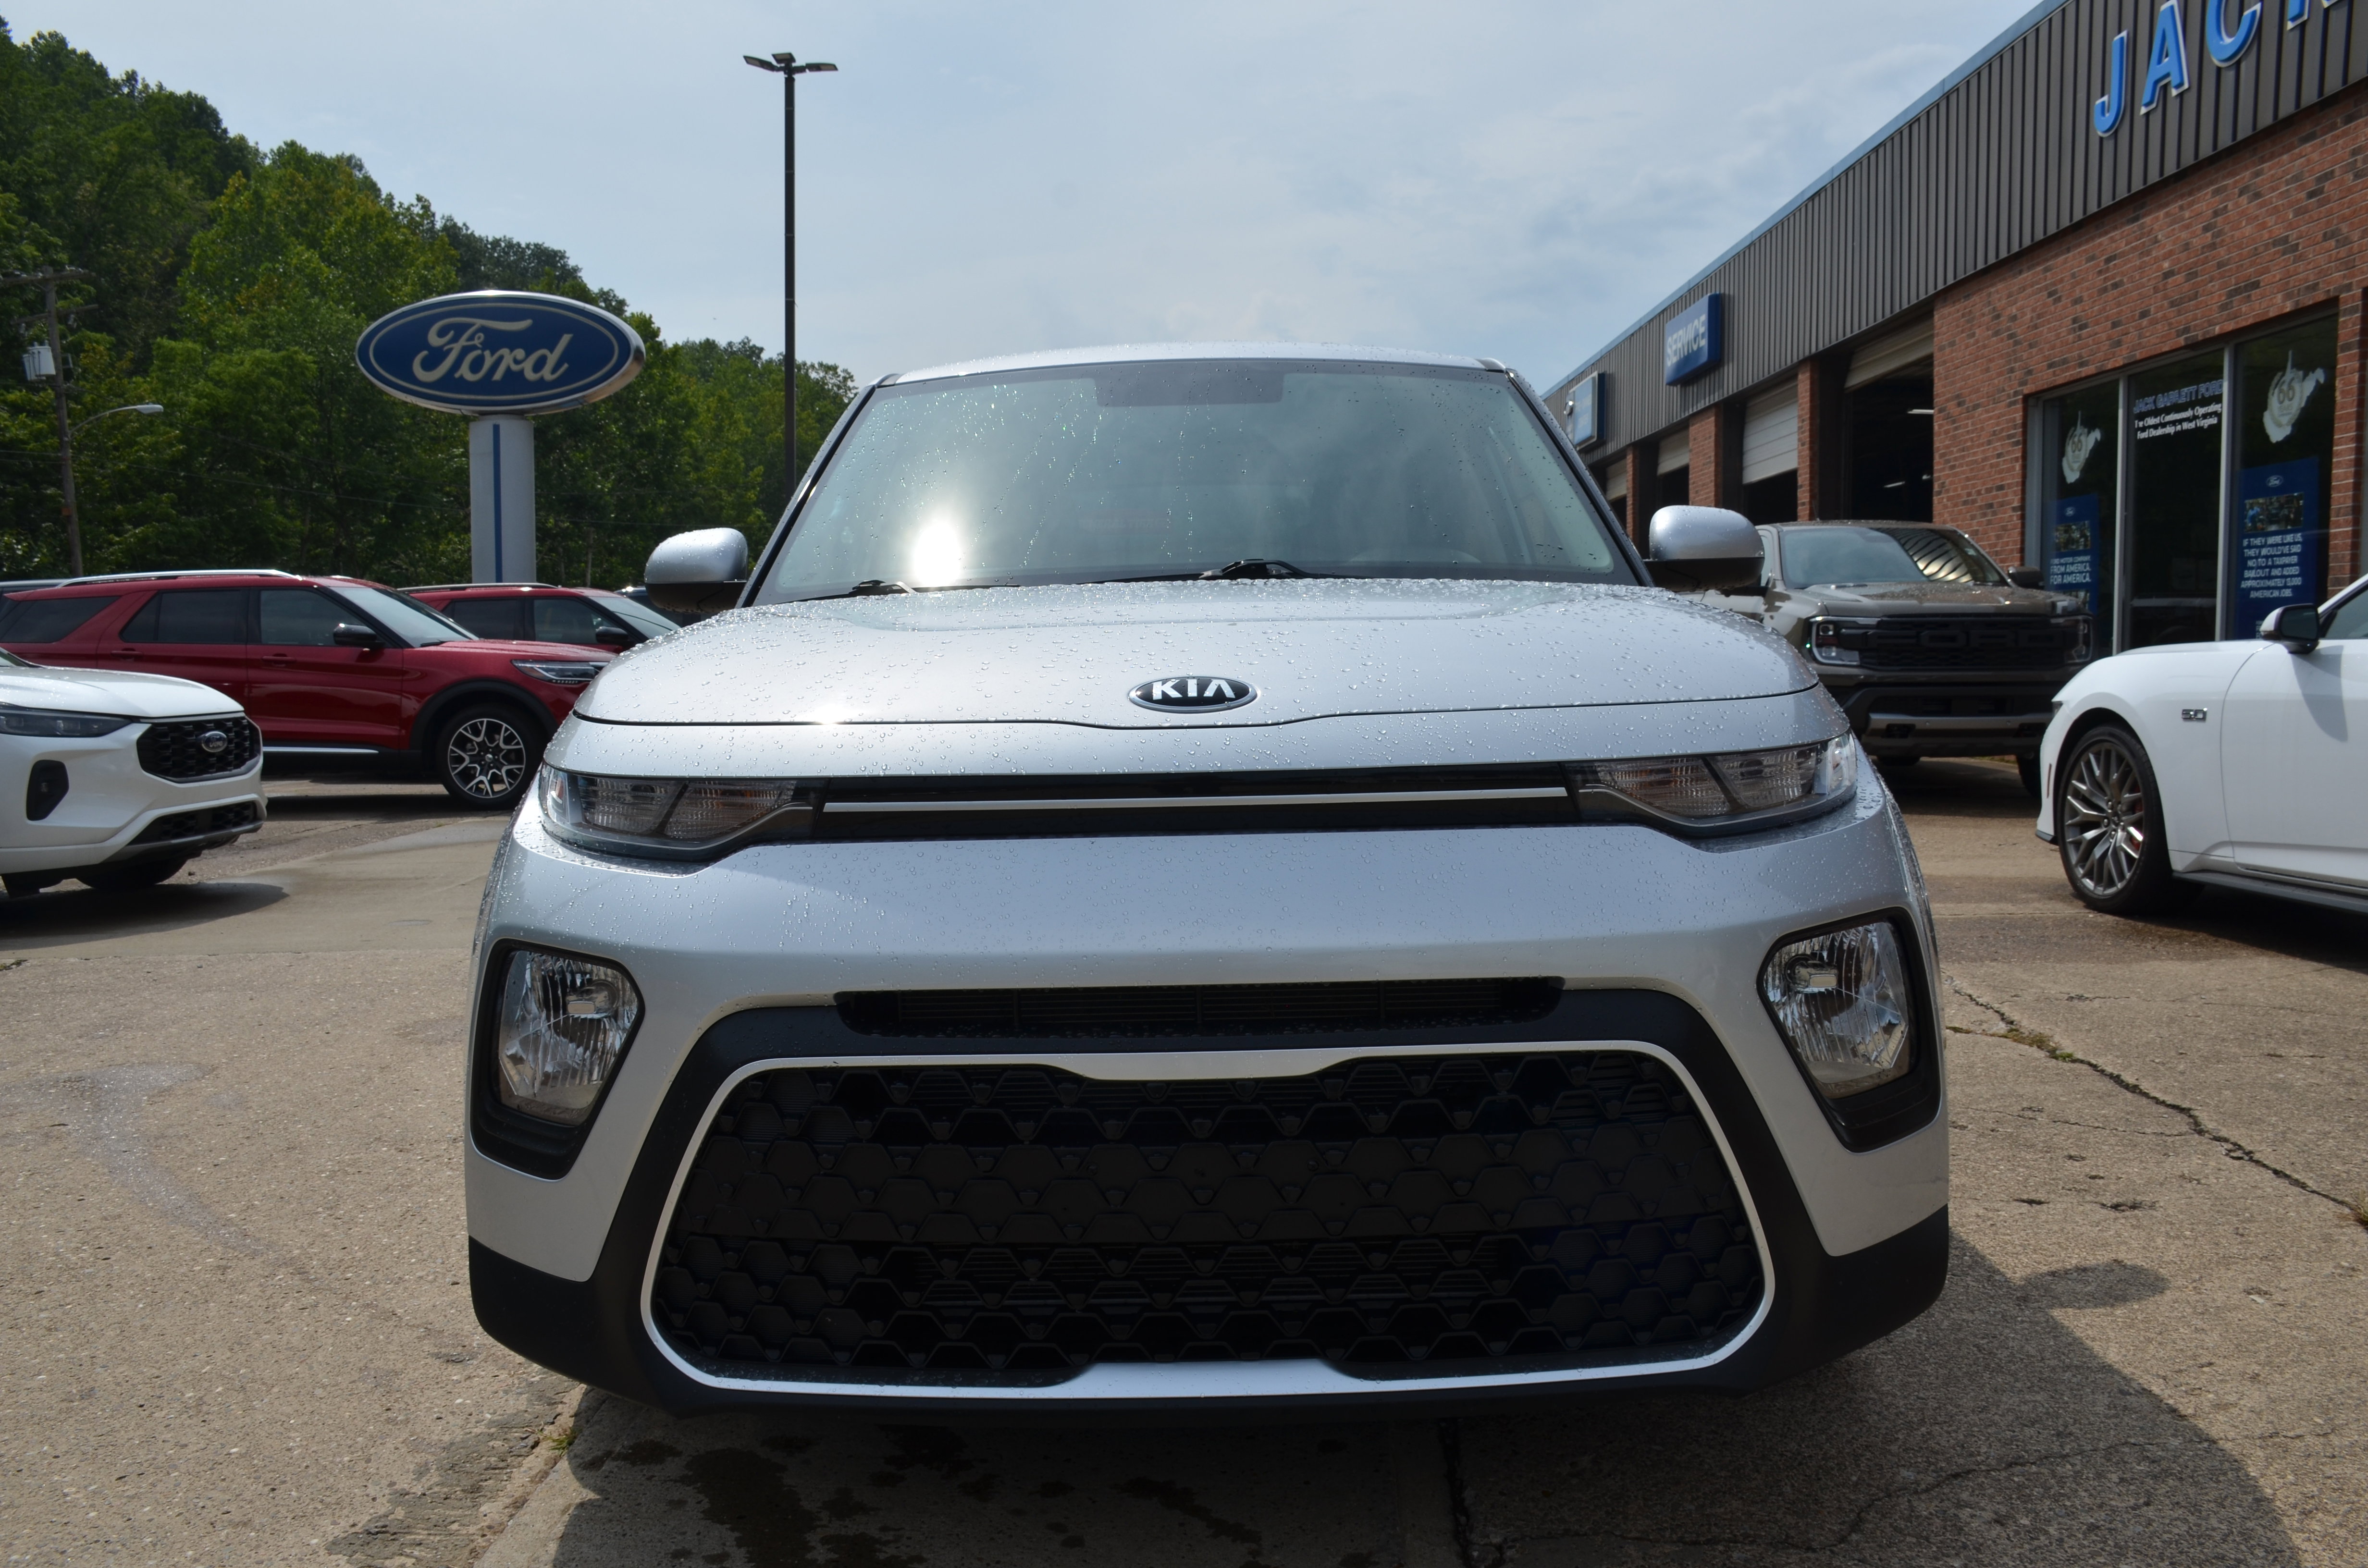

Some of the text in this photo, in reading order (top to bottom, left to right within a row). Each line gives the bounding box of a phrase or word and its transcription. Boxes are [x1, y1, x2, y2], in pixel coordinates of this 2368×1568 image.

[2093, 0, 2340, 137] JAC
[412, 317, 573, 383] Ford
[1667, 314, 1705, 367] SERVICE
[2134, 379, 2223, 414] JACK GARRETT FORD
[2277, 377, 2295, 404] 66
[2144, 416, 2160, 427] Oldest
[2160, 407, 2194, 423] Continuously
[2194, 402, 2222, 417] Operating
[2137, 415, 2218, 440] Ford Dealership in West Virginia
[2071, 433, 2083, 453] 66
[2243, 533, 2302, 547] IF THEY WERE LIKE US,
[2244, 544, 2301, 557] THEY WOULD'VE SAID
[2050, 563, 2092, 574] FROM AMERICA.
[2257, 558, 2266, 566] TO
[2273, 555, 2298, 565] TAXPAYER
[2050, 572, 2092, 584] FOR AMERICA.
[2244, 566, 2300, 578] BAILOUT AND ADDED
[2240, 578, 2286, 588] APPROXIMATELY
[2249, 589, 2279, 598] AMERICAN
[1870, 630, 2065, 649] FORD
[1152, 679, 1235, 700] KIA
[2182, 708, 2207, 722] 5.0
